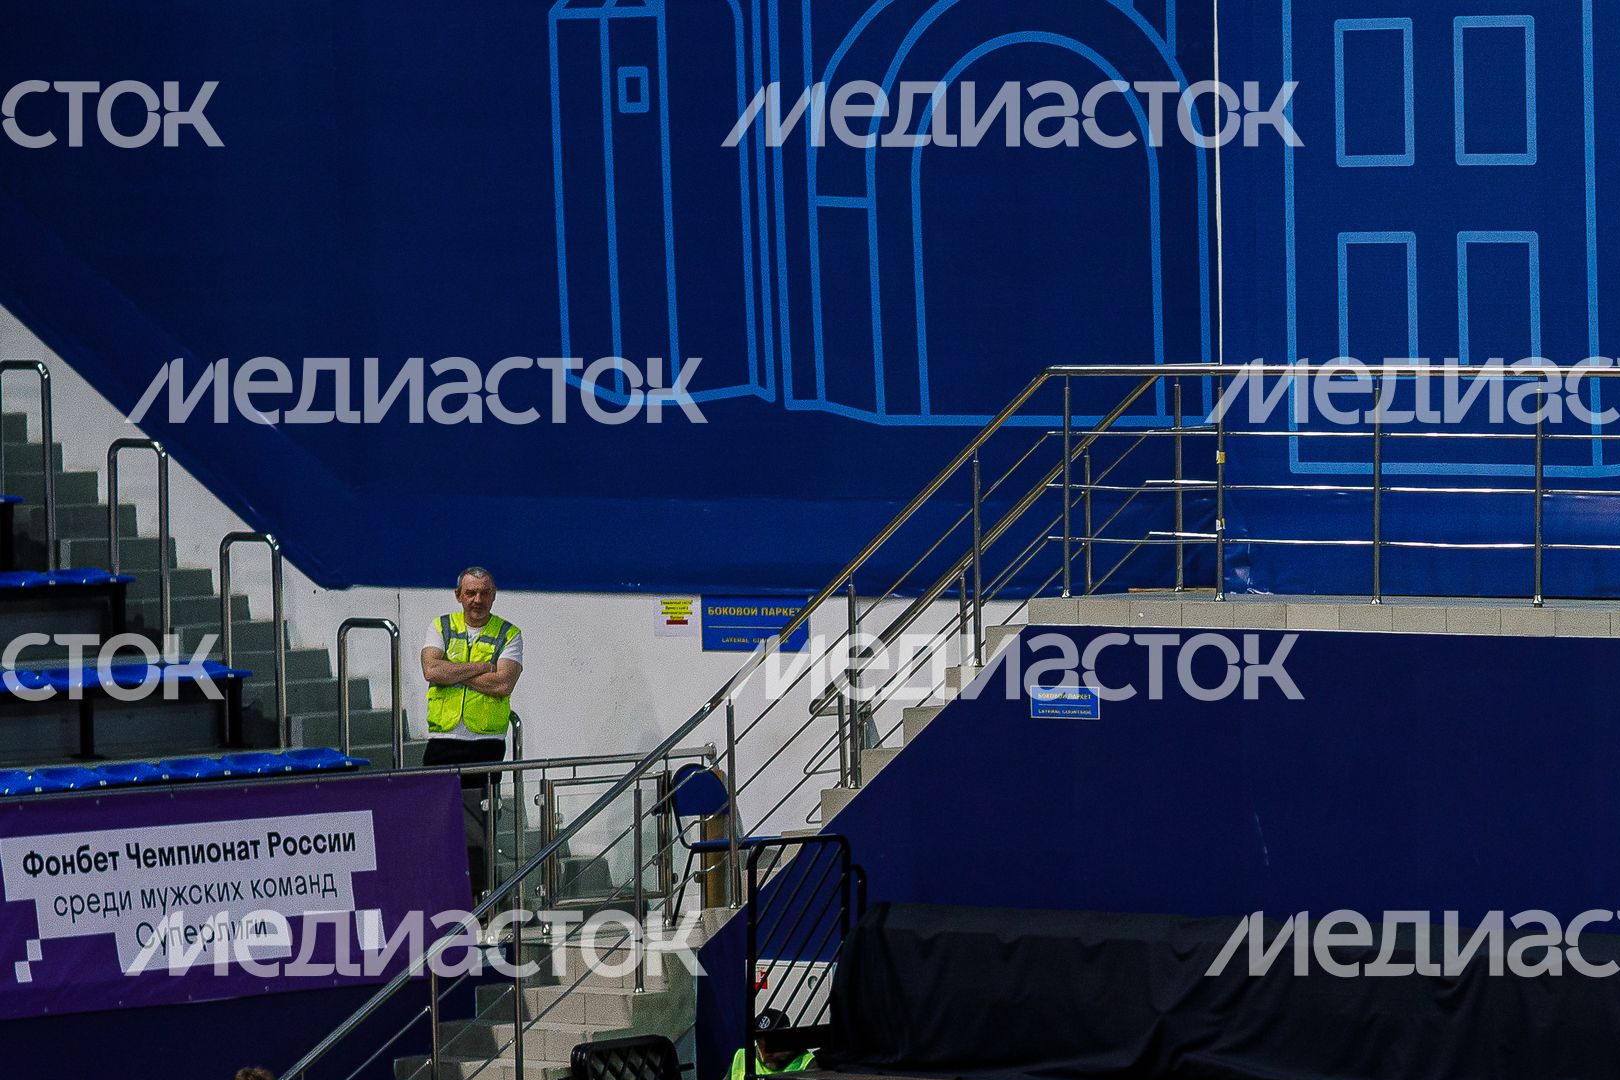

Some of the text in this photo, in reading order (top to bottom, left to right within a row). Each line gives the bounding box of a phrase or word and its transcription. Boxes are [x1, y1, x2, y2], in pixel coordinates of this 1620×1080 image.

[707, 604, 758, 616] БОКОВОЙ
[22, 831, 357, 878] Фонбет Чемпионат России
[53, 870, 339, 923] среди мужских команд
[135, 917, 268, 955] Суперлиги
